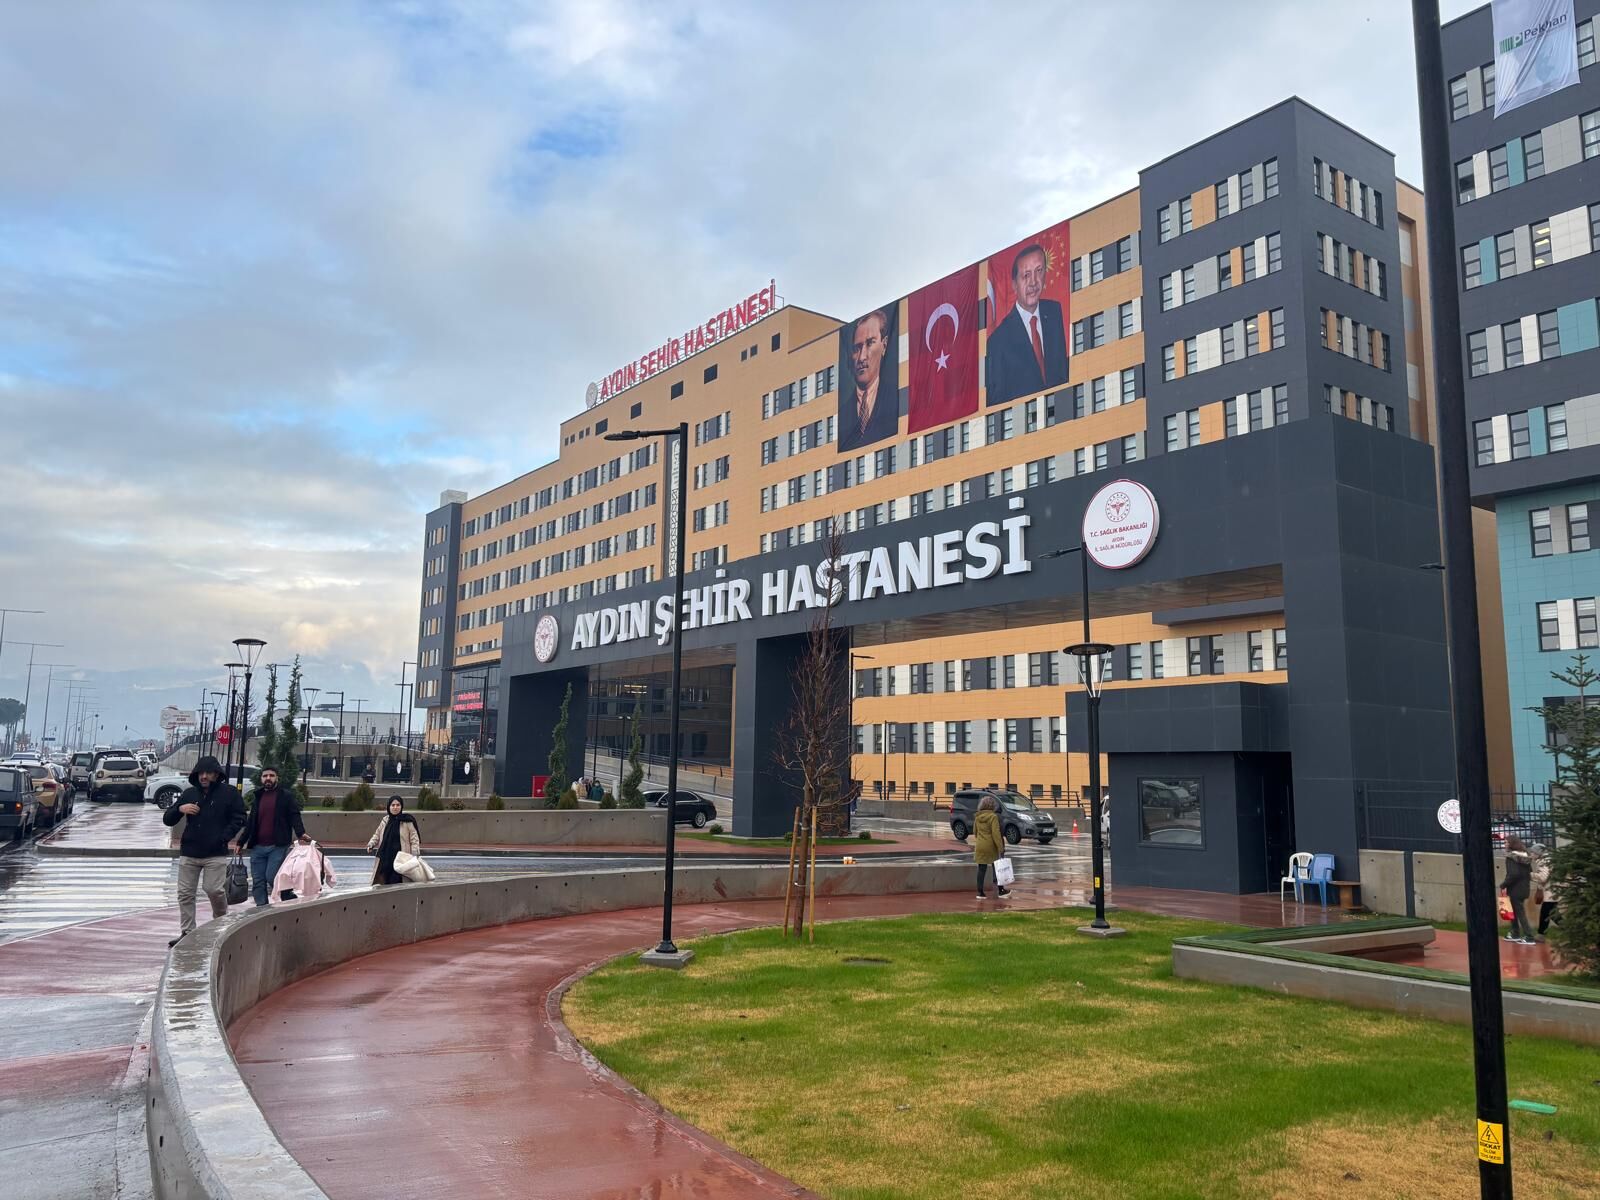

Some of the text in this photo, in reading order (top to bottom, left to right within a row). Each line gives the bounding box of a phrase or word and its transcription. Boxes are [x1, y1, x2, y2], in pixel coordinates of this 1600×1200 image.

[1524, 14, 1567, 39] Pekhan
[600, 278, 776, 400] AYDIN ŞEHİR HASTANESİ
[1099, 527, 1118, 536] SAĞLIK
[1118, 522, 1148, 532] BAKANLIĞI
[570, 496, 1032, 650] AYDIN ŞEHİR HASTANESİ
